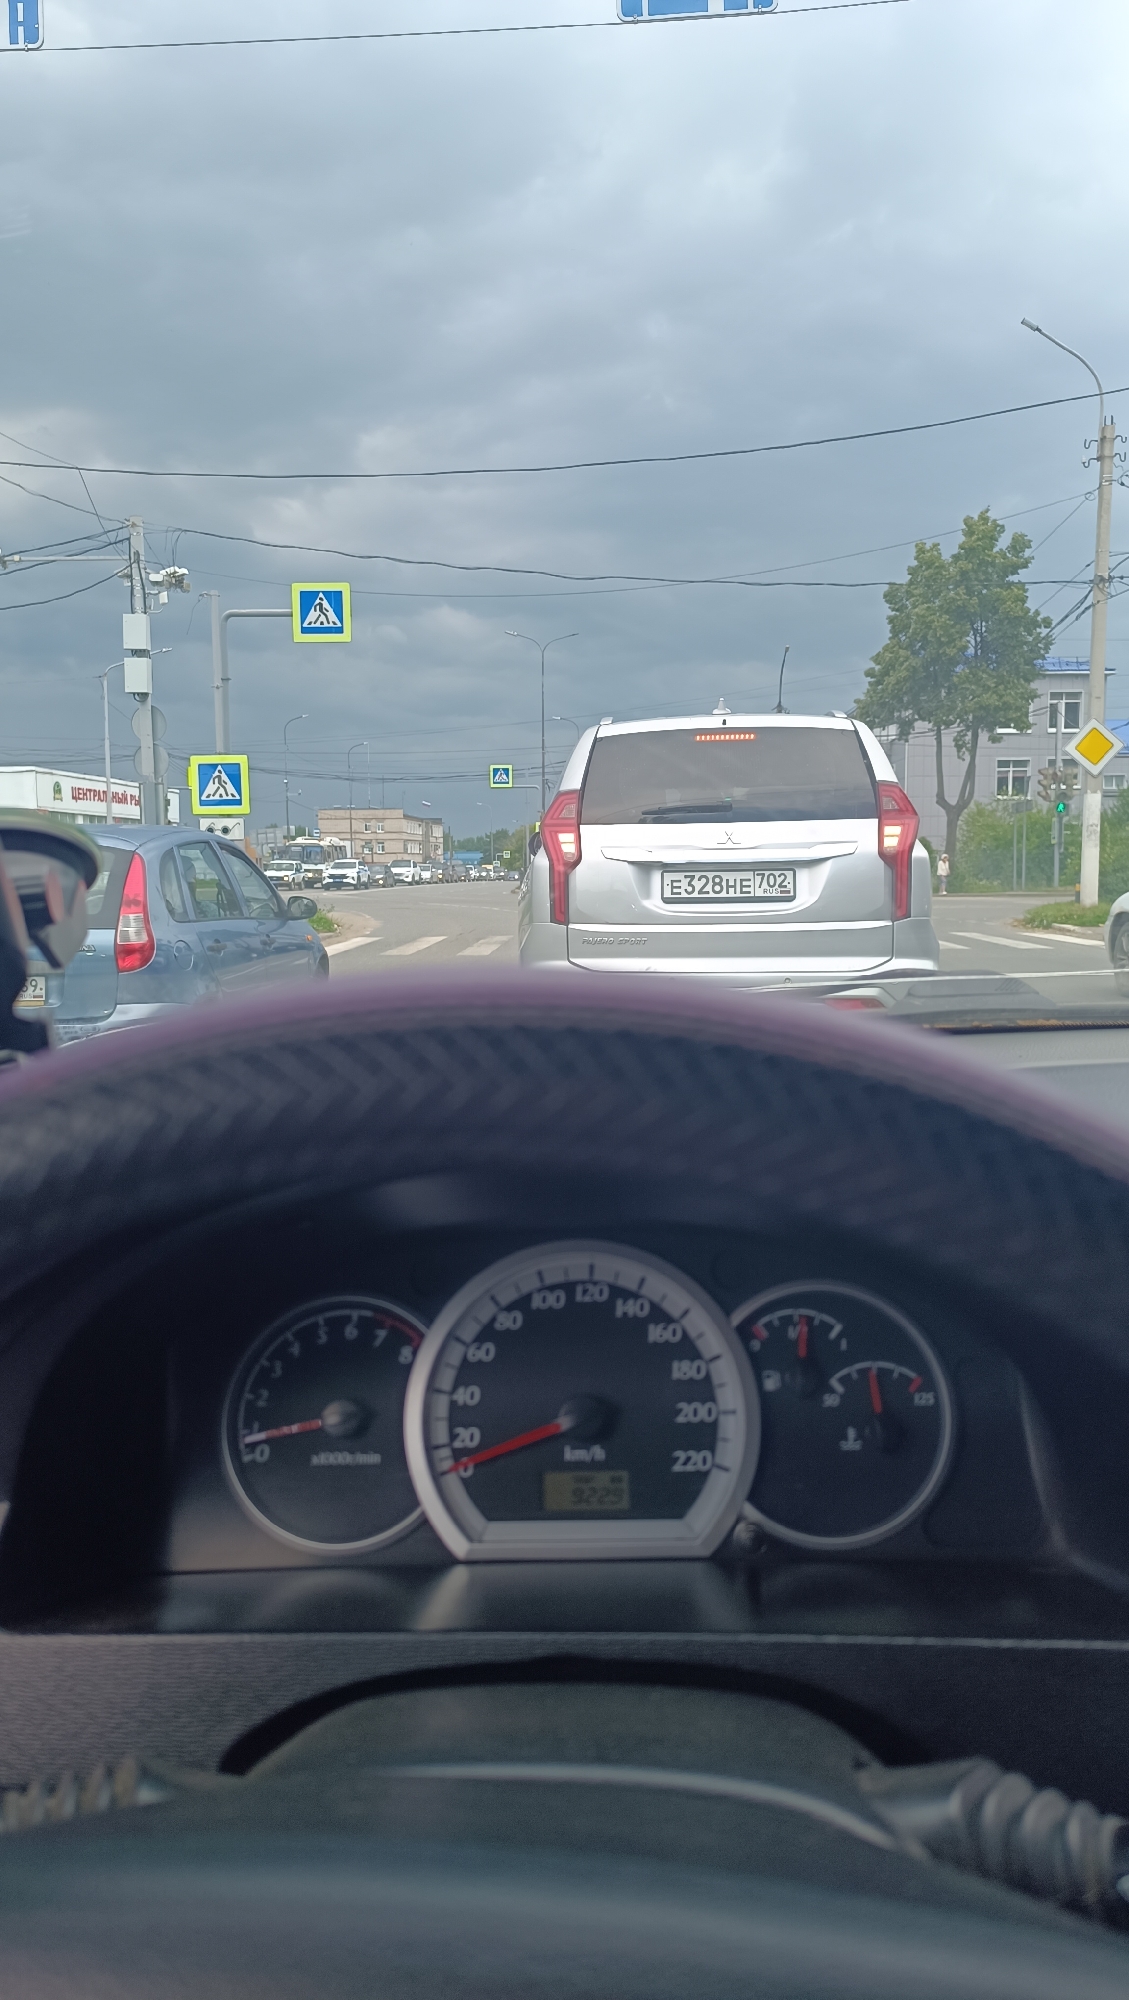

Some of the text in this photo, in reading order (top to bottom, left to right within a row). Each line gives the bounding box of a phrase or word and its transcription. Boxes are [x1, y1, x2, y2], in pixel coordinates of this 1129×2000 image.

[71, 786, 128, 805] ЦЕНТРАЛНЫЙ
[756, 873, 788, 889] 702
[581, 937, 648, 946] PAJERO SPORT
[530, 1289, 566, 1310] 100
[574, 1283, 610, 1303] 120
[614, 1298, 650, 1318] 140
[493, 1310, 523, 1331] 80
[344, 1324, 358, 1341] 6
[372, 1328, 389, 1348] 7
[647, 1322, 683, 1343] 160
[398, 1345, 413, 1365] 8
[466, 1342, 496, 1362] 60
[671, 1359, 707, 1380] 180
[453, 1385, 482, 1406] 40
[674, 1401, 718, 1424] 200
[453, 1426, 482, 1449] 20
[563, 1444, 606, 1463] km/h
[671, 1449, 713, 1473] 220
